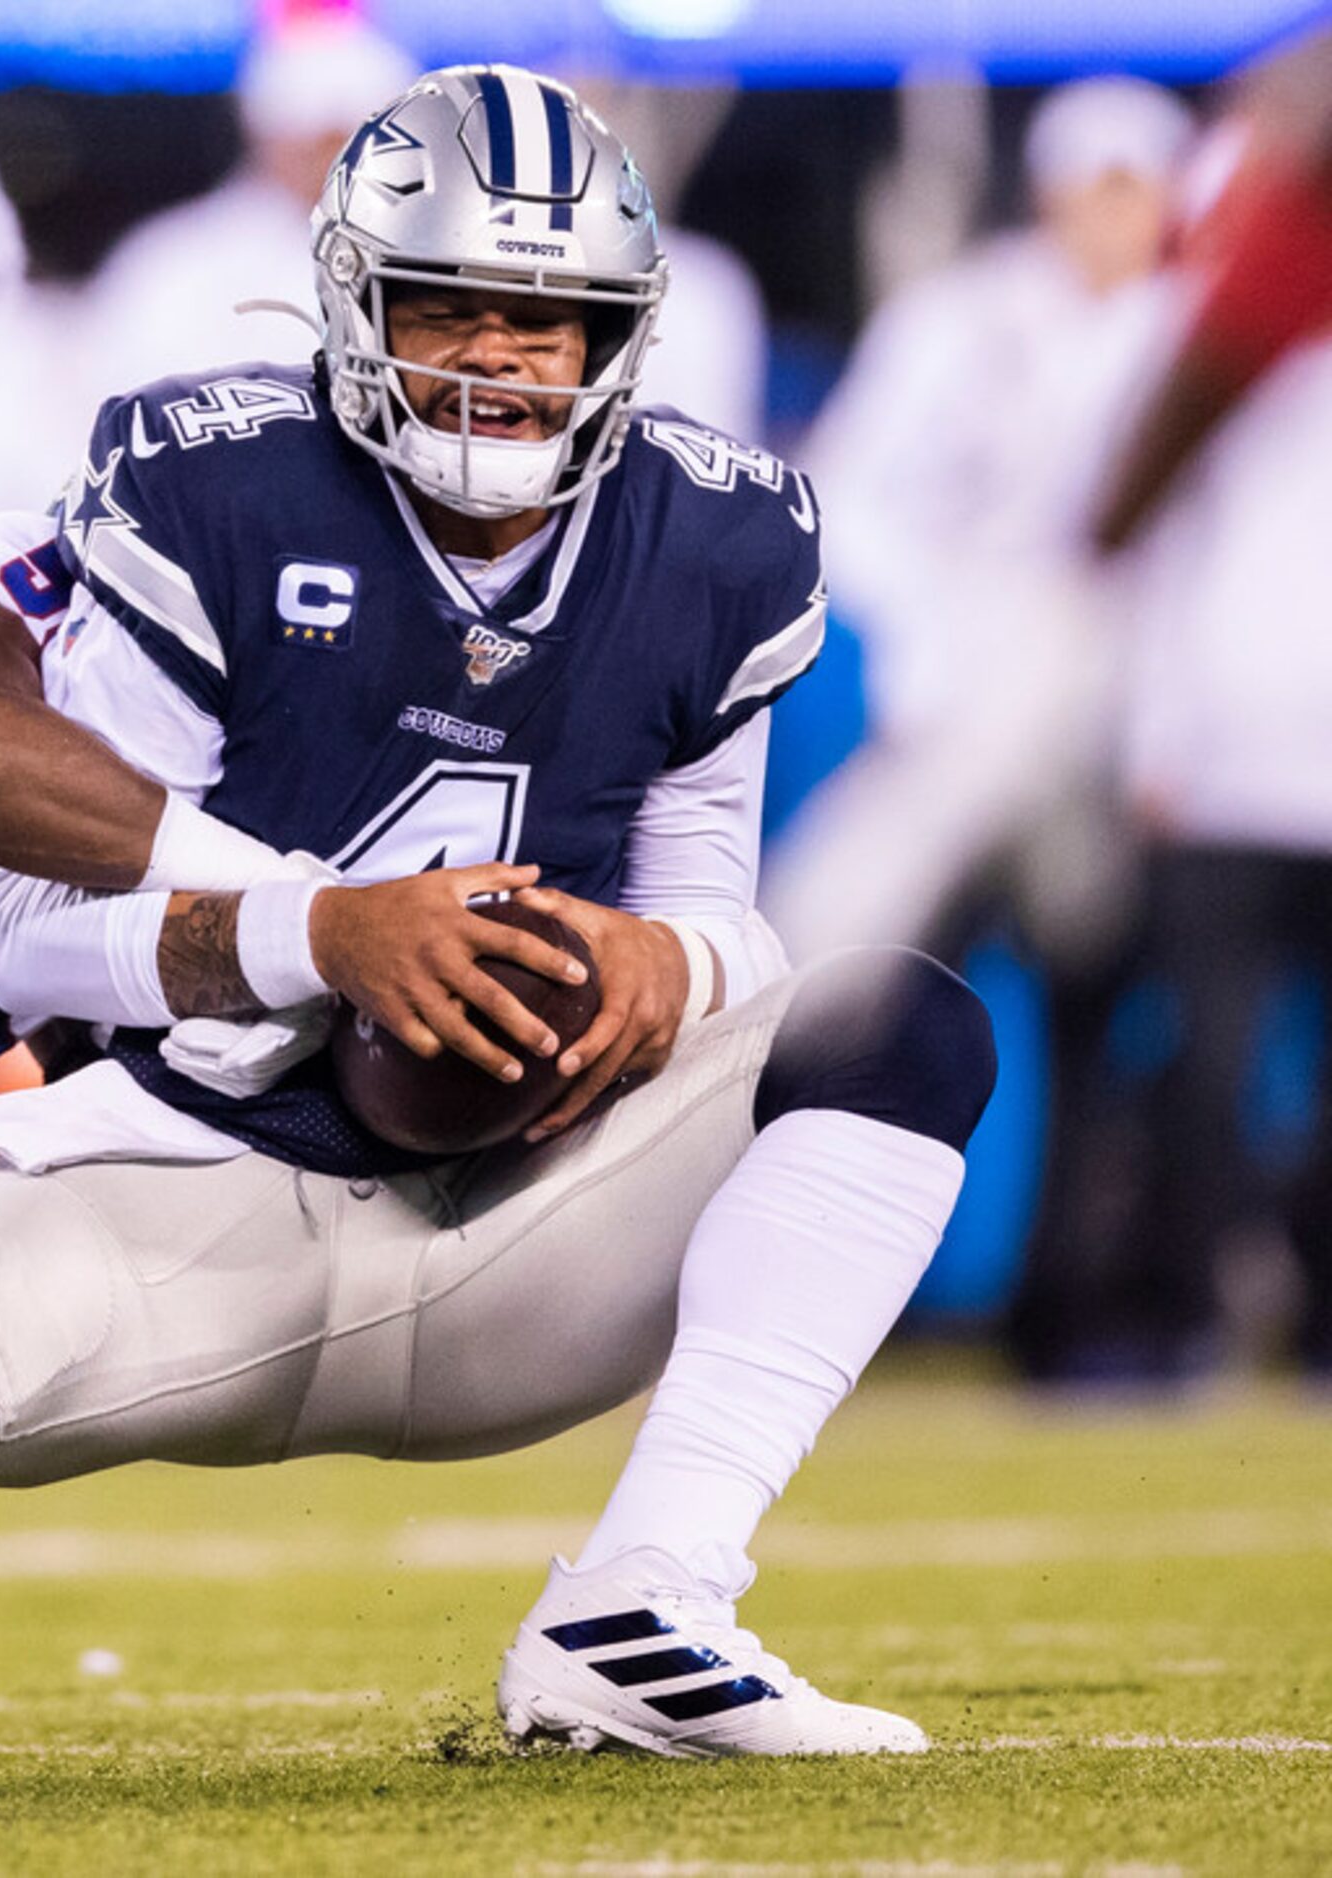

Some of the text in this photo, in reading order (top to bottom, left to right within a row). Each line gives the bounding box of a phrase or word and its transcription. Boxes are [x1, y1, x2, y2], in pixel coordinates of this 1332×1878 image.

[496, 239, 565, 258] COWBOYS
[163, 377, 316, 450] 4
[642, 418, 783, 493] 4
[276, 562, 355, 628] C
[322, 759, 531, 902] 4
